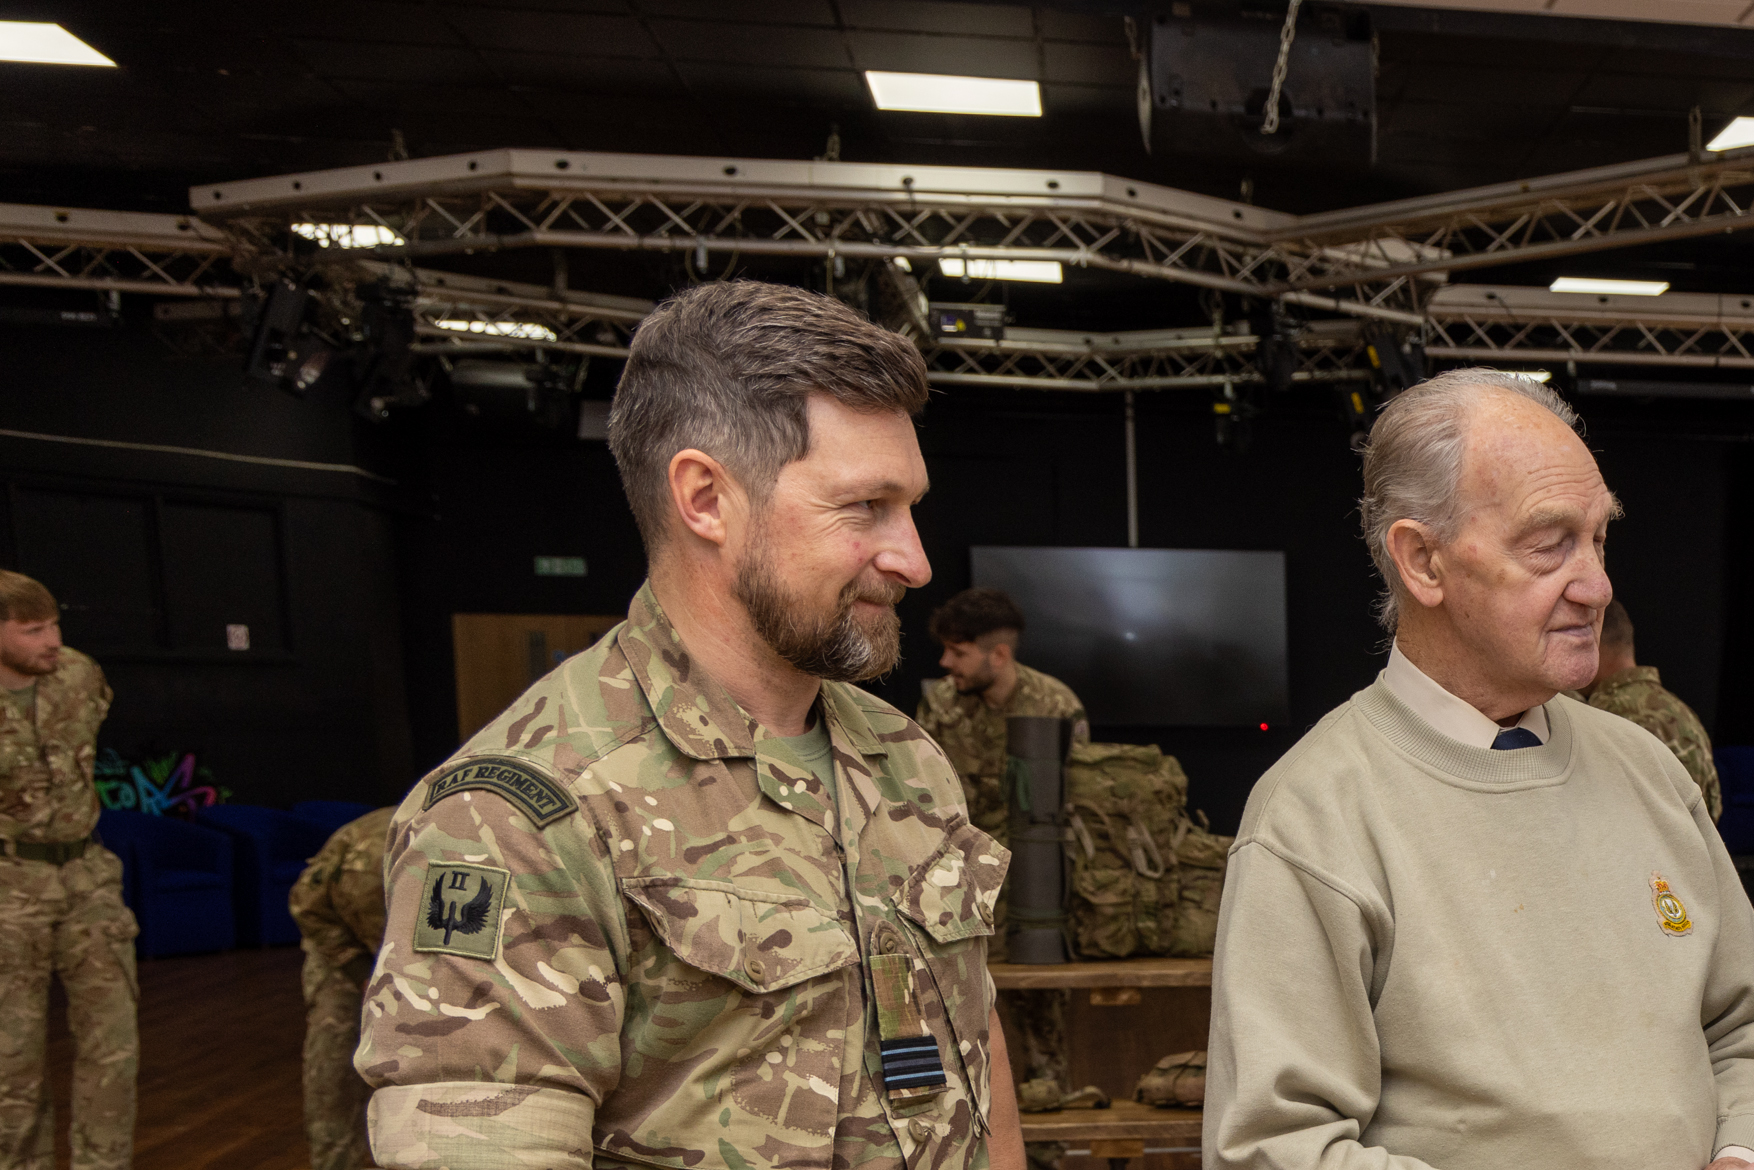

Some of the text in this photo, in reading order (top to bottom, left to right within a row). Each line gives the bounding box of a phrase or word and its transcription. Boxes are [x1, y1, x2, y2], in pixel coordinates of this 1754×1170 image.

[435, 766, 557, 809] RAF REGIMENT
[448, 870, 470, 891] II
